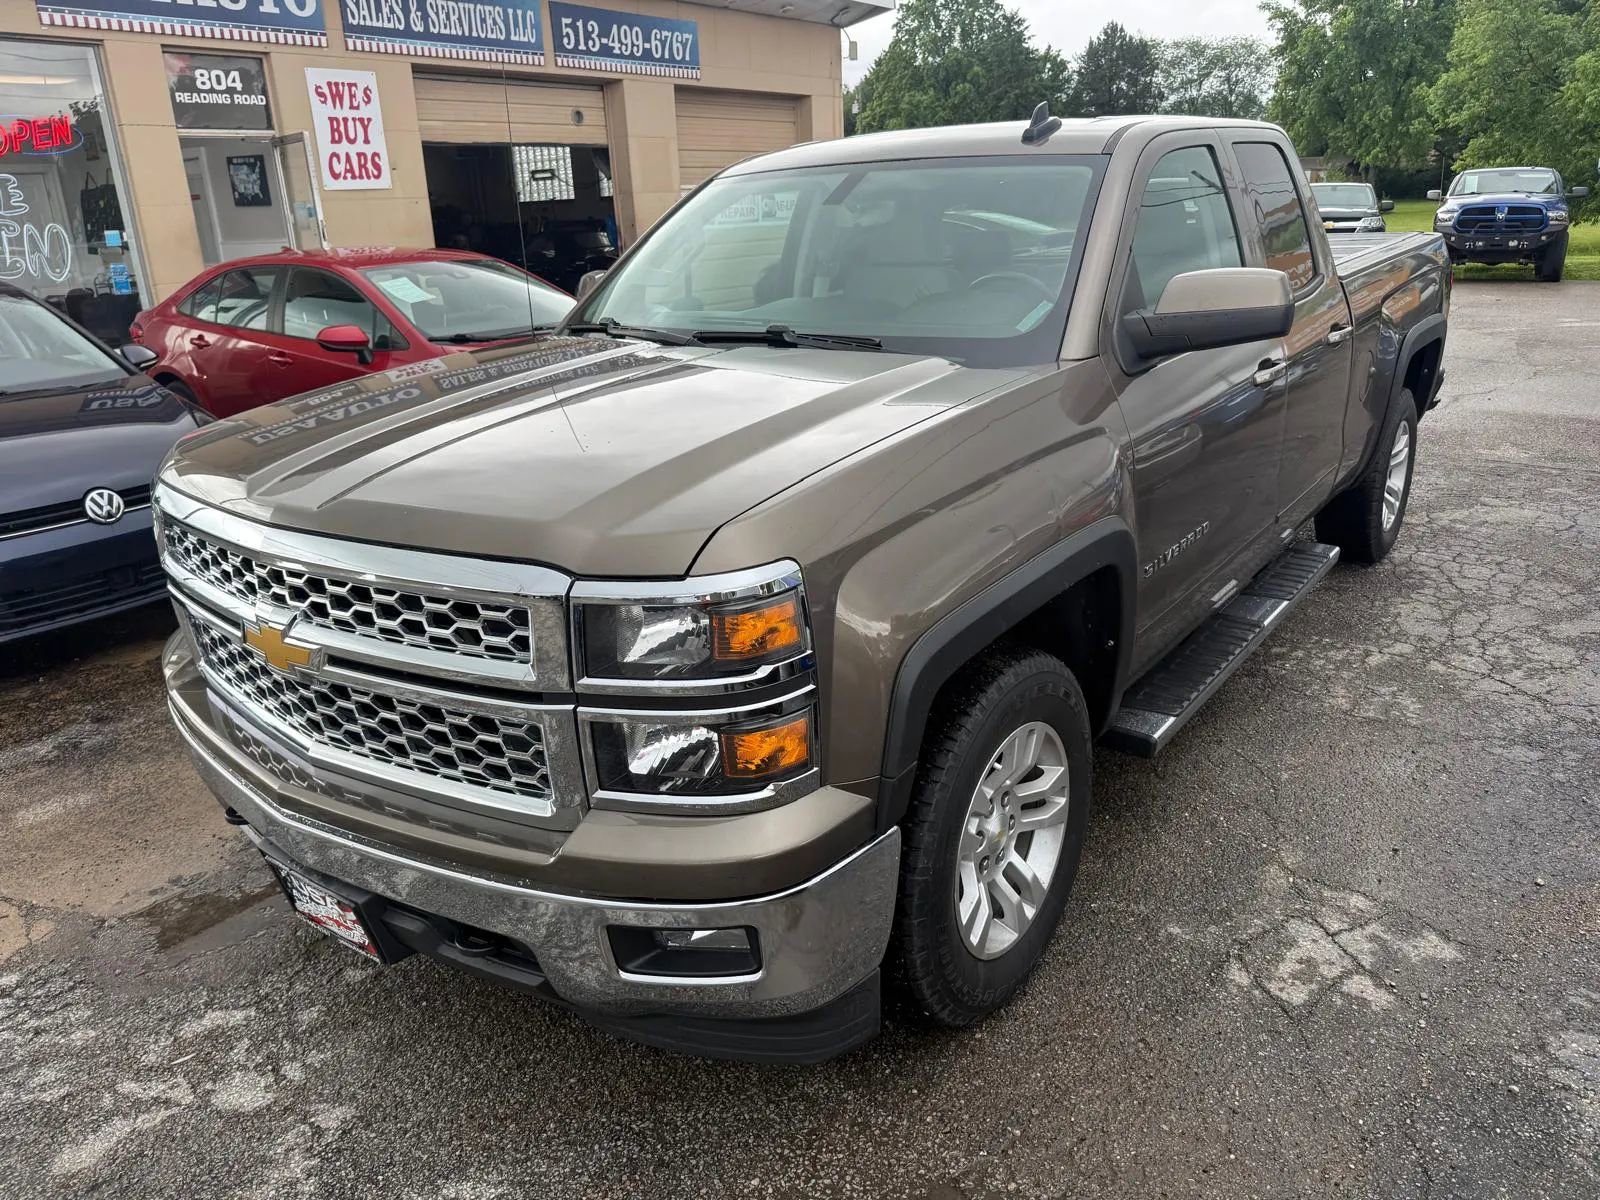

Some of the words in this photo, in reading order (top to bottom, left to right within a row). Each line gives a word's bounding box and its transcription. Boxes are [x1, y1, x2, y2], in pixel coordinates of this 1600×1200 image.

[346, 0, 405, 31] SALES
[409, 0, 424, 33] &
[426, 0, 506, 41] SERVICES
[507, 7, 537, 44] LLC
[561, 16, 694, 62] 513-499-6767
[193, 68, 243, 92] 804
[175, 92, 231, 105] READING
[234, 94, 266, 106] ROAD
[327, 116, 373, 145] BUY
[328, 151, 383, 181] CARS
[1143, 520, 1210, 578] SILVERADO
